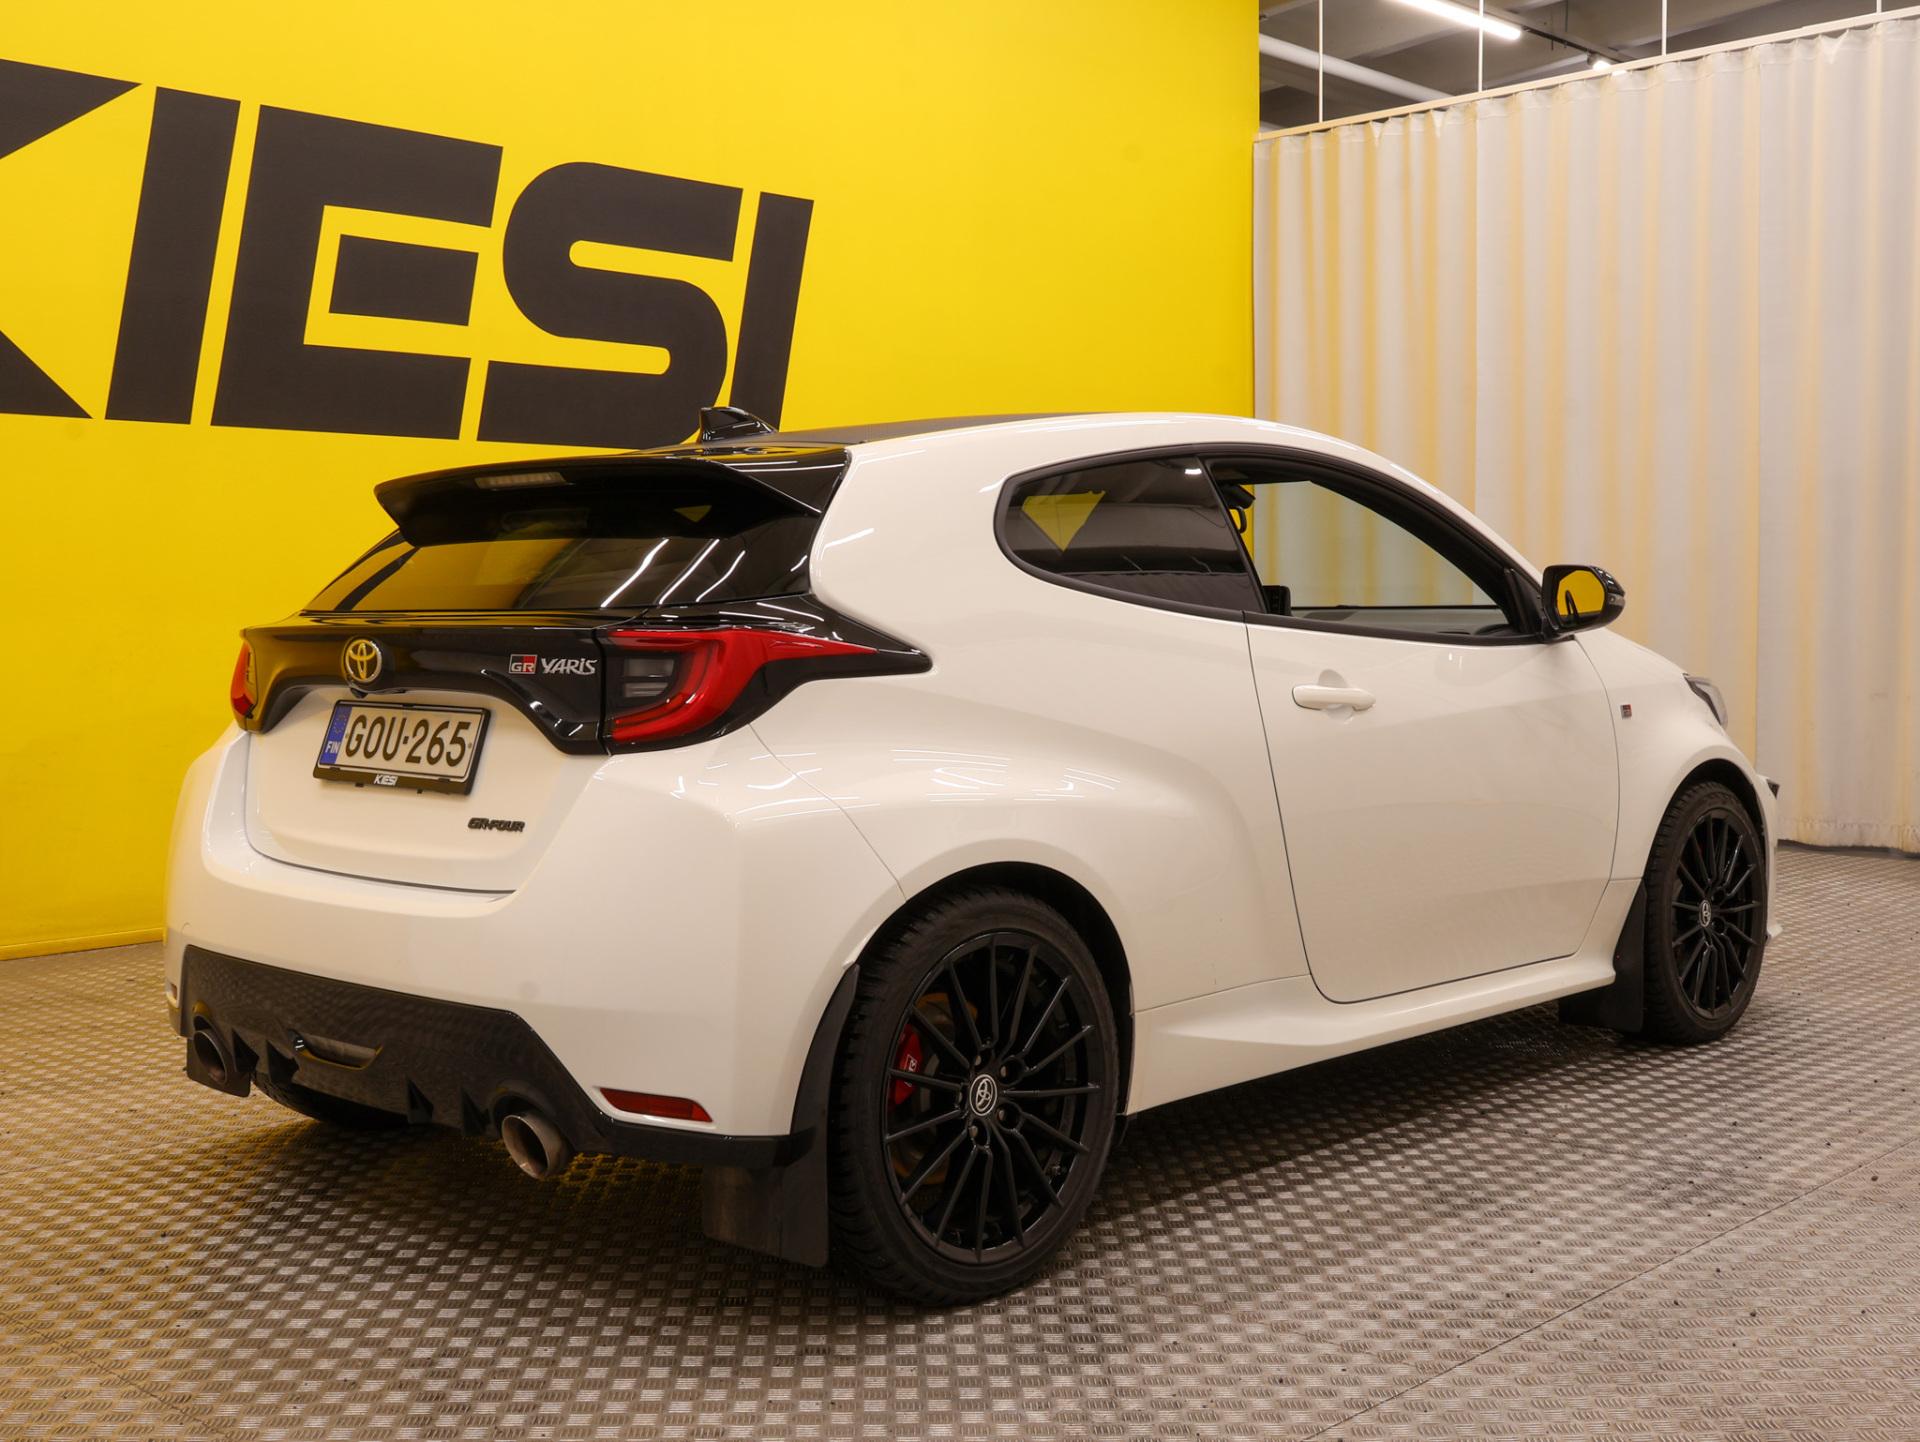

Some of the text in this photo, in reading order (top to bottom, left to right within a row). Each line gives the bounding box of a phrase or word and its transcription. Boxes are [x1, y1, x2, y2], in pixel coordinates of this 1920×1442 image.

[510, 661, 537, 673] GR
[325, 740, 341, 753] FIN
[345, 714, 472, 767] GOU-265
[373, 774, 399, 786] KIESI
[467, 817, 526, 832] GR-FOUR
